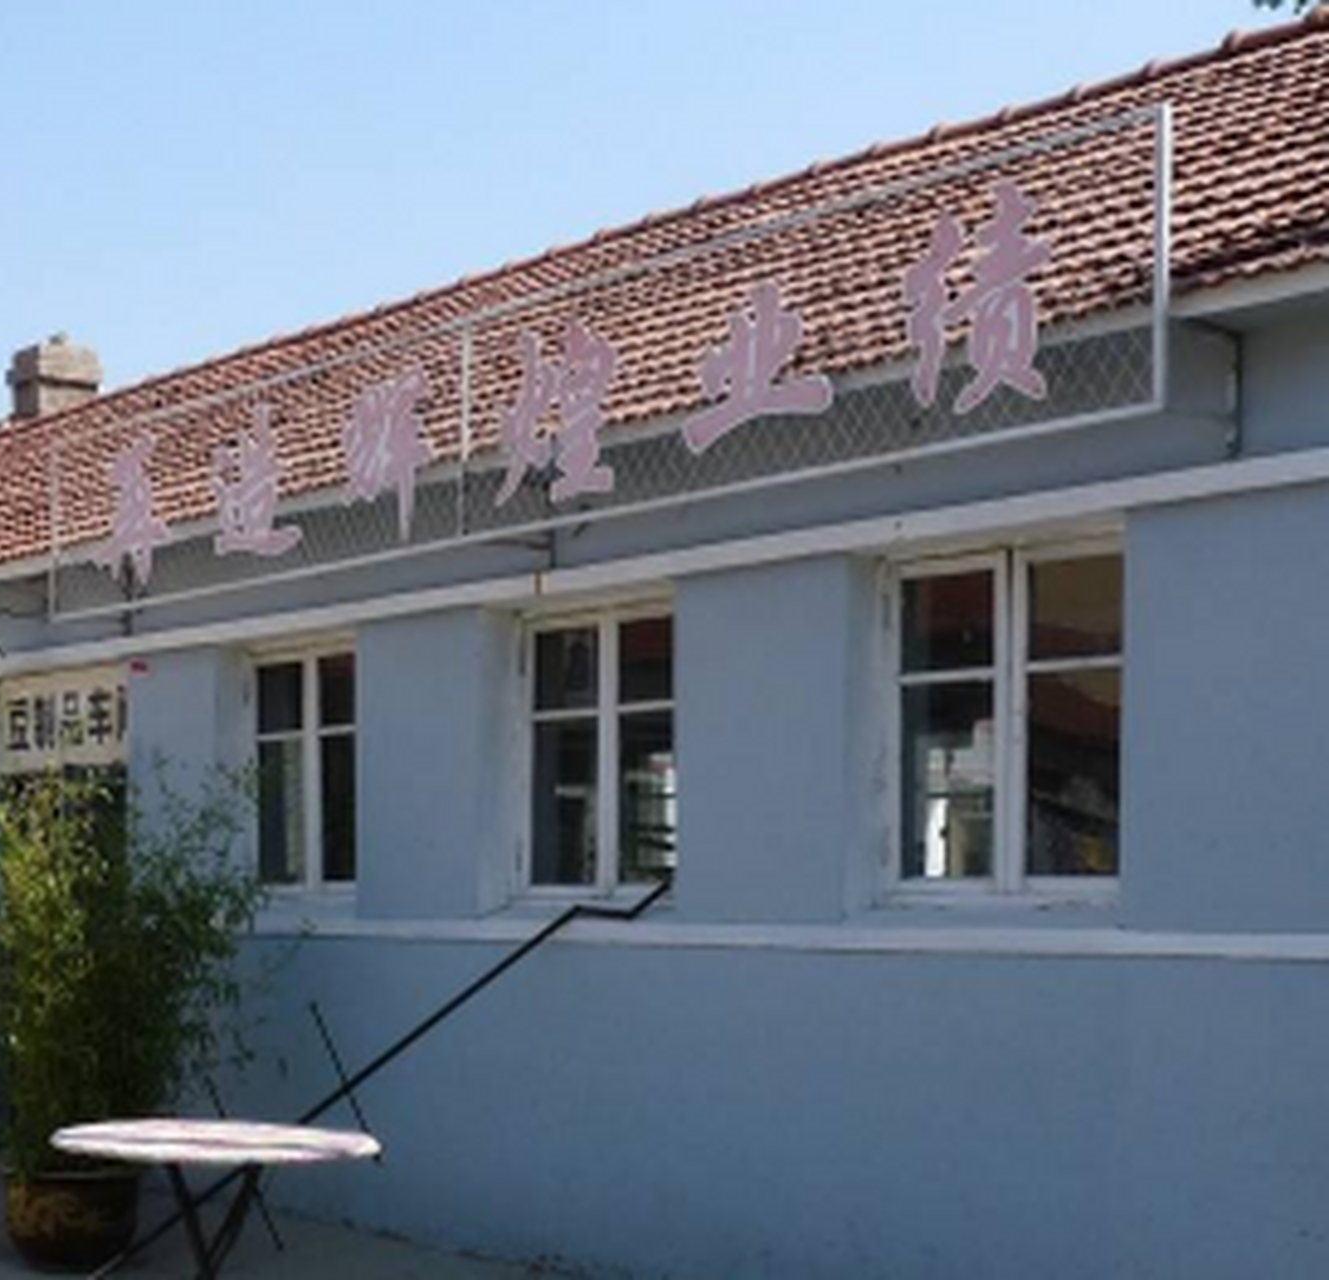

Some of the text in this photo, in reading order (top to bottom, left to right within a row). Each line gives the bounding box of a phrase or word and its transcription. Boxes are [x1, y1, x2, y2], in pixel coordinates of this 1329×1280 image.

[87, 179, 1053, 585] 再造辉煌业绩
